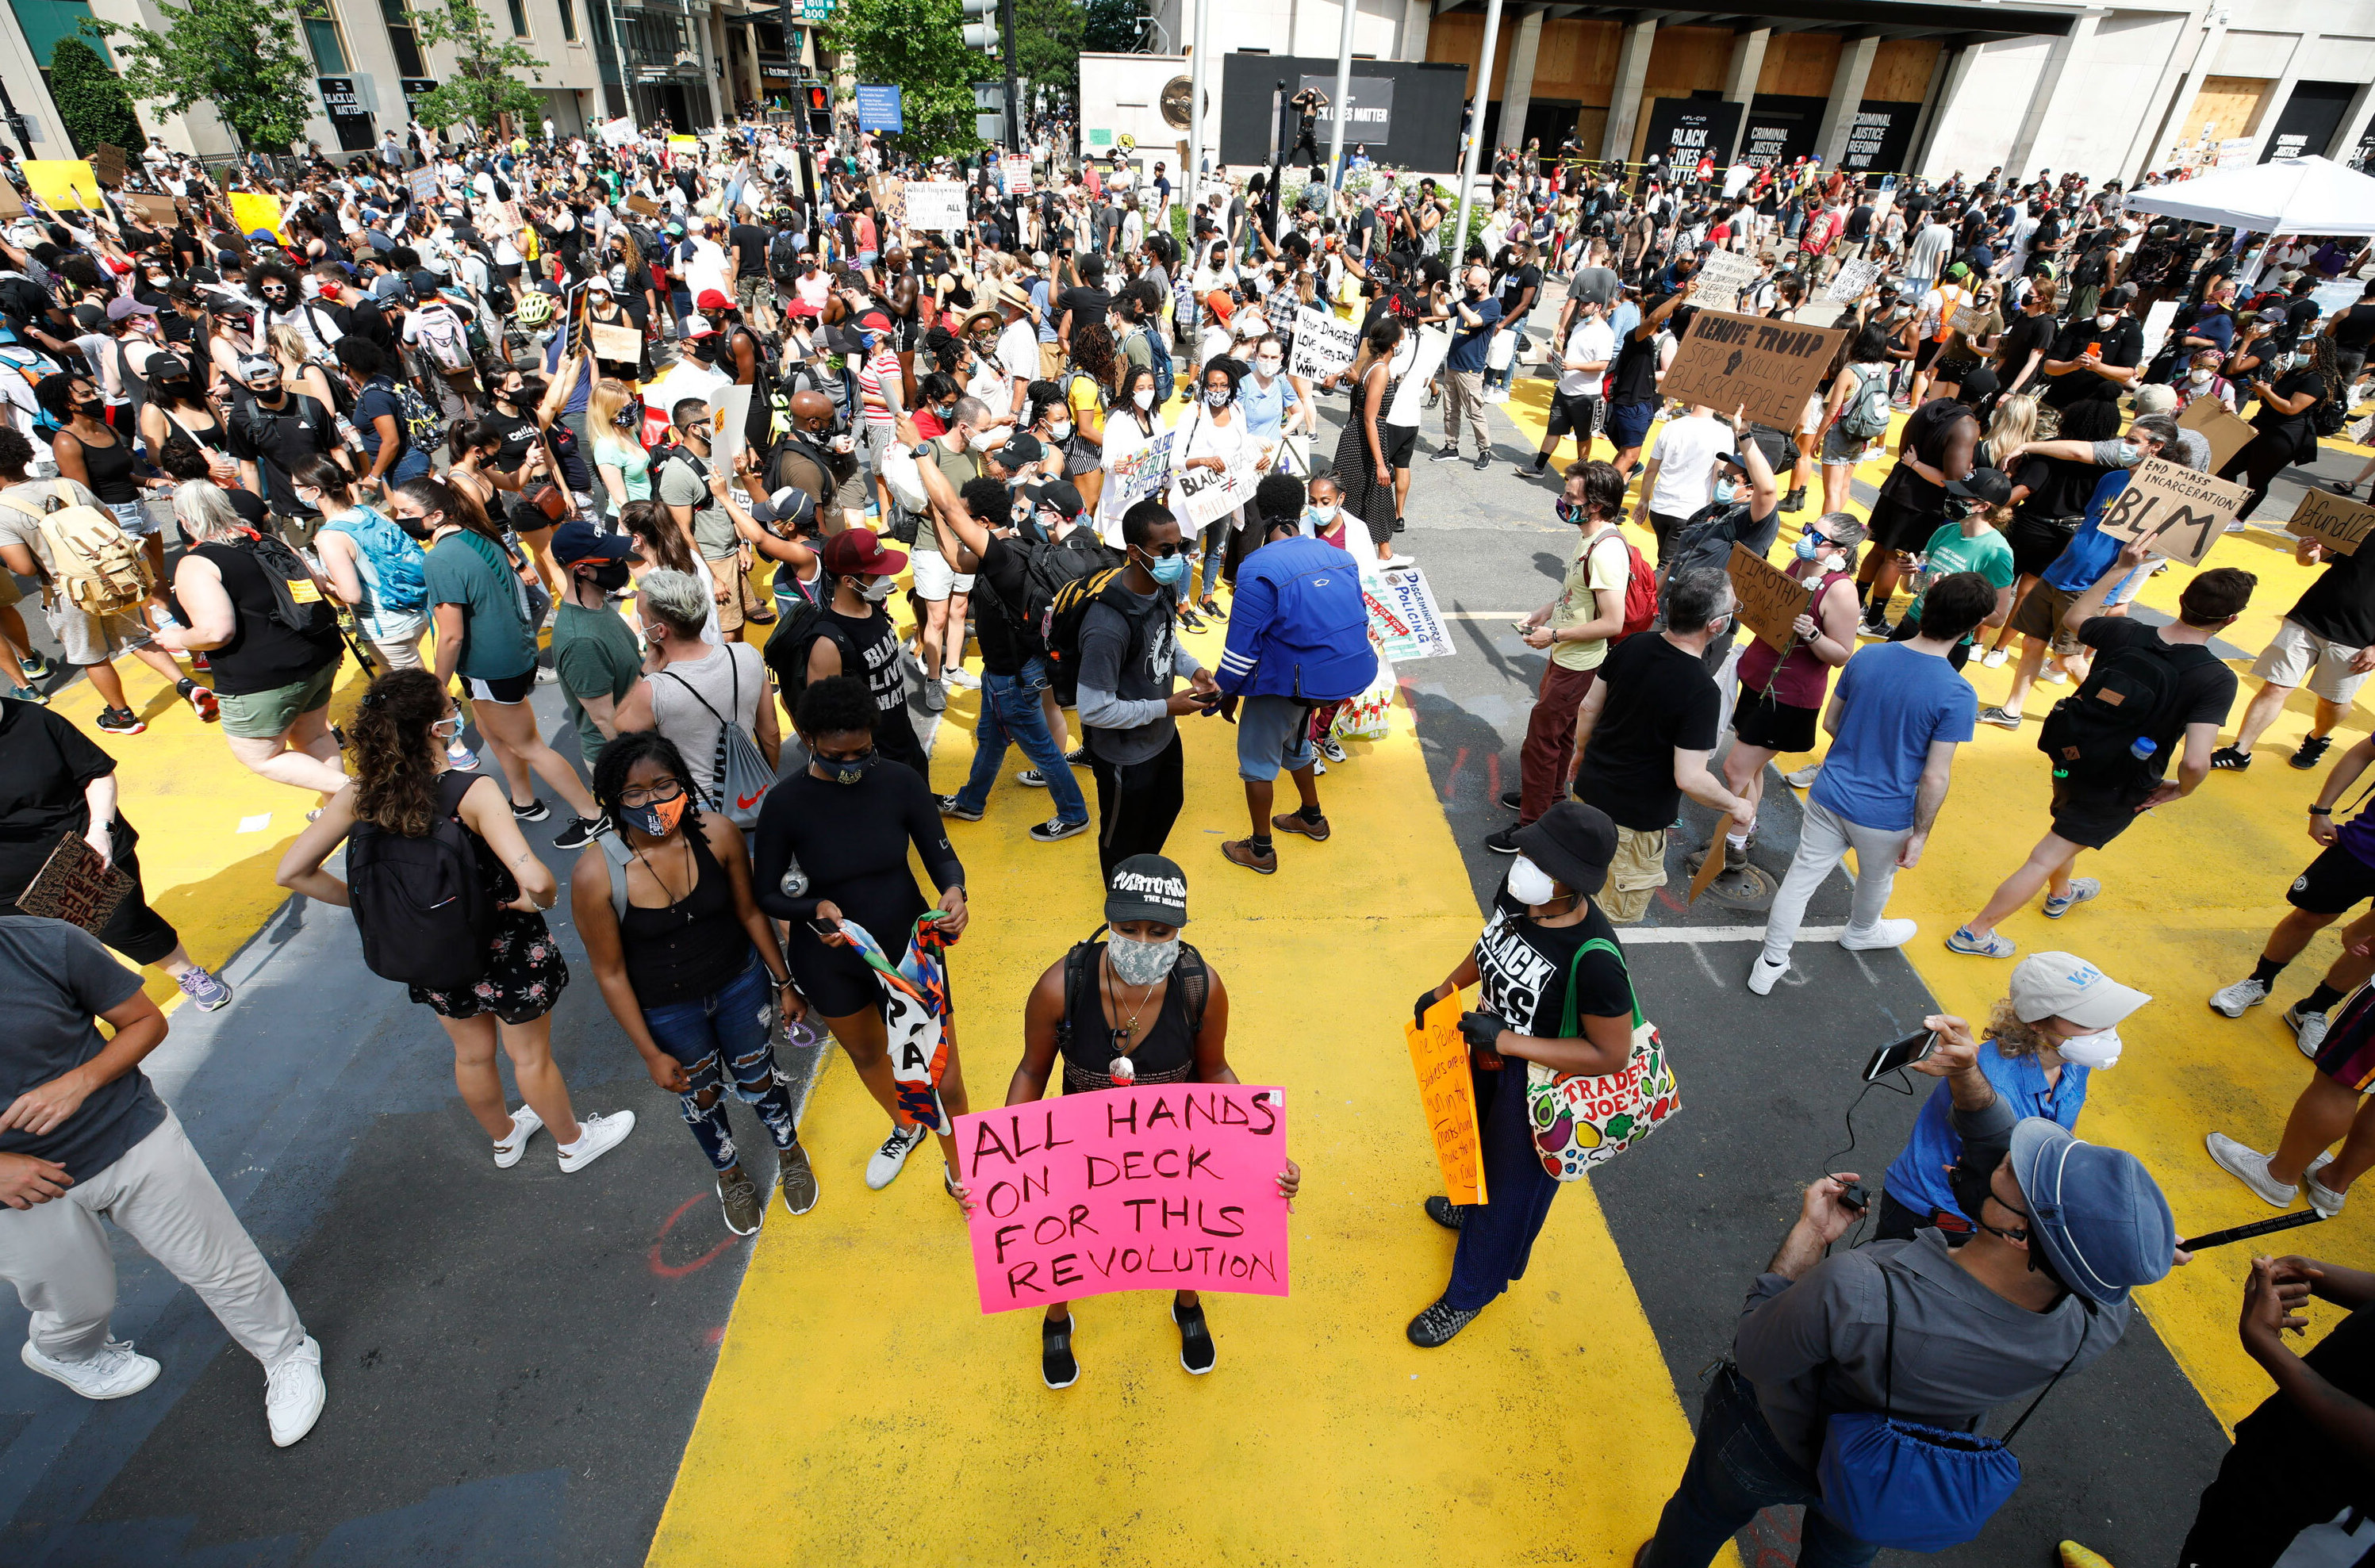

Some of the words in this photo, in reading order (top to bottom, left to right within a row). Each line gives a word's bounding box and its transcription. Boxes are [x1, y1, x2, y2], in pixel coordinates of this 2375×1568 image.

[804, 9, 825, 19] 800
[324, 93, 345, 104] BLACK
[345, 93, 358, 104] LIV
[1354, 108, 1387, 122] MATTER
[1854, 113, 1891, 127] CRIMINAL
[1671, 128, 1708, 148] BLACK
[1752, 127, 1788, 141] CRIMINAL
[1847, 140, 1882, 154] REFORM
[1852, 127, 1886, 140] JUSTICE
[2277, 134, 2308, 147] CRIMINAL
[1750, 141, 1783, 155] JUSTICE
[1848, 155, 1872, 167] NOW!
[2273, 146, 2301, 158] JUSTICE
[1847, 267, 1872, 282] TRUTH
[1303, 312, 1318, 332] Your
[1320, 320, 1358, 349] DAUGHTERS
[1693, 316, 1755, 347] REMOVE
[1754, 325, 1824, 359] TRUMP
[1295, 351, 1303, 360] of
[1298, 332, 1317, 351] LOVE
[1320, 346, 1334, 362] every
[1337, 351, 1353, 364] INCH
[1296, 361, 1317, 378] WHY
[1684, 342, 1726, 368] STOP
[1739, 353, 1805, 386] KILLING
[1666, 364, 1732, 401] BLACK
[1727, 380, 1795, 421] PEOPLE
[1179, 468, 1226, 497] BLACK
[2144, 460, 2170, 475] END
[2178, 470, 2211, 486] MASS
[2144, 473, 2237, 511] INCARCERATION
[2103, 486, 2215, 558] BLM
[1740, 550, 1802, 607] TIMOTHY
[1403, 572, 1442, 642] DISCRIMINATORY
[1734, 572, 1782, 621] THOMAS
[1364, 594, 1377, 608] BAD
[1379, 607, 1391, 618] FOR
[1390, 617, 1407, 633] YOUR
[1395, 586, 1429, 643] POLICING
[1148, 637, 1157, 658] BLACK
[647, 808, 670, 824] BLACK
[649, 820, 673, 834] POPULAR
[65, 872, 104, 906] NAMES
[1144, 895, 1160, 903] THE
[1482, 908, 1552, 991] BLACK
[2066, 966, 2099, 986] VOA
[1564, 1055, 1648, 1105] TRADER
[1583, 1087, 1640, 1122] JOE'S
[972, 1110, 1074, 1179] ALL
[1107, 1092, 1276, 1139] HANDS
[985, 1167, 1049, 1218] ON
[1084, 1144, 1225, 1191] DECK
[995, 1204, 1100, 1265] FOR
[1123, 1196, 1245, 1238] THIS
[1007, 1244, 1278, 1299] REVOLUTION
